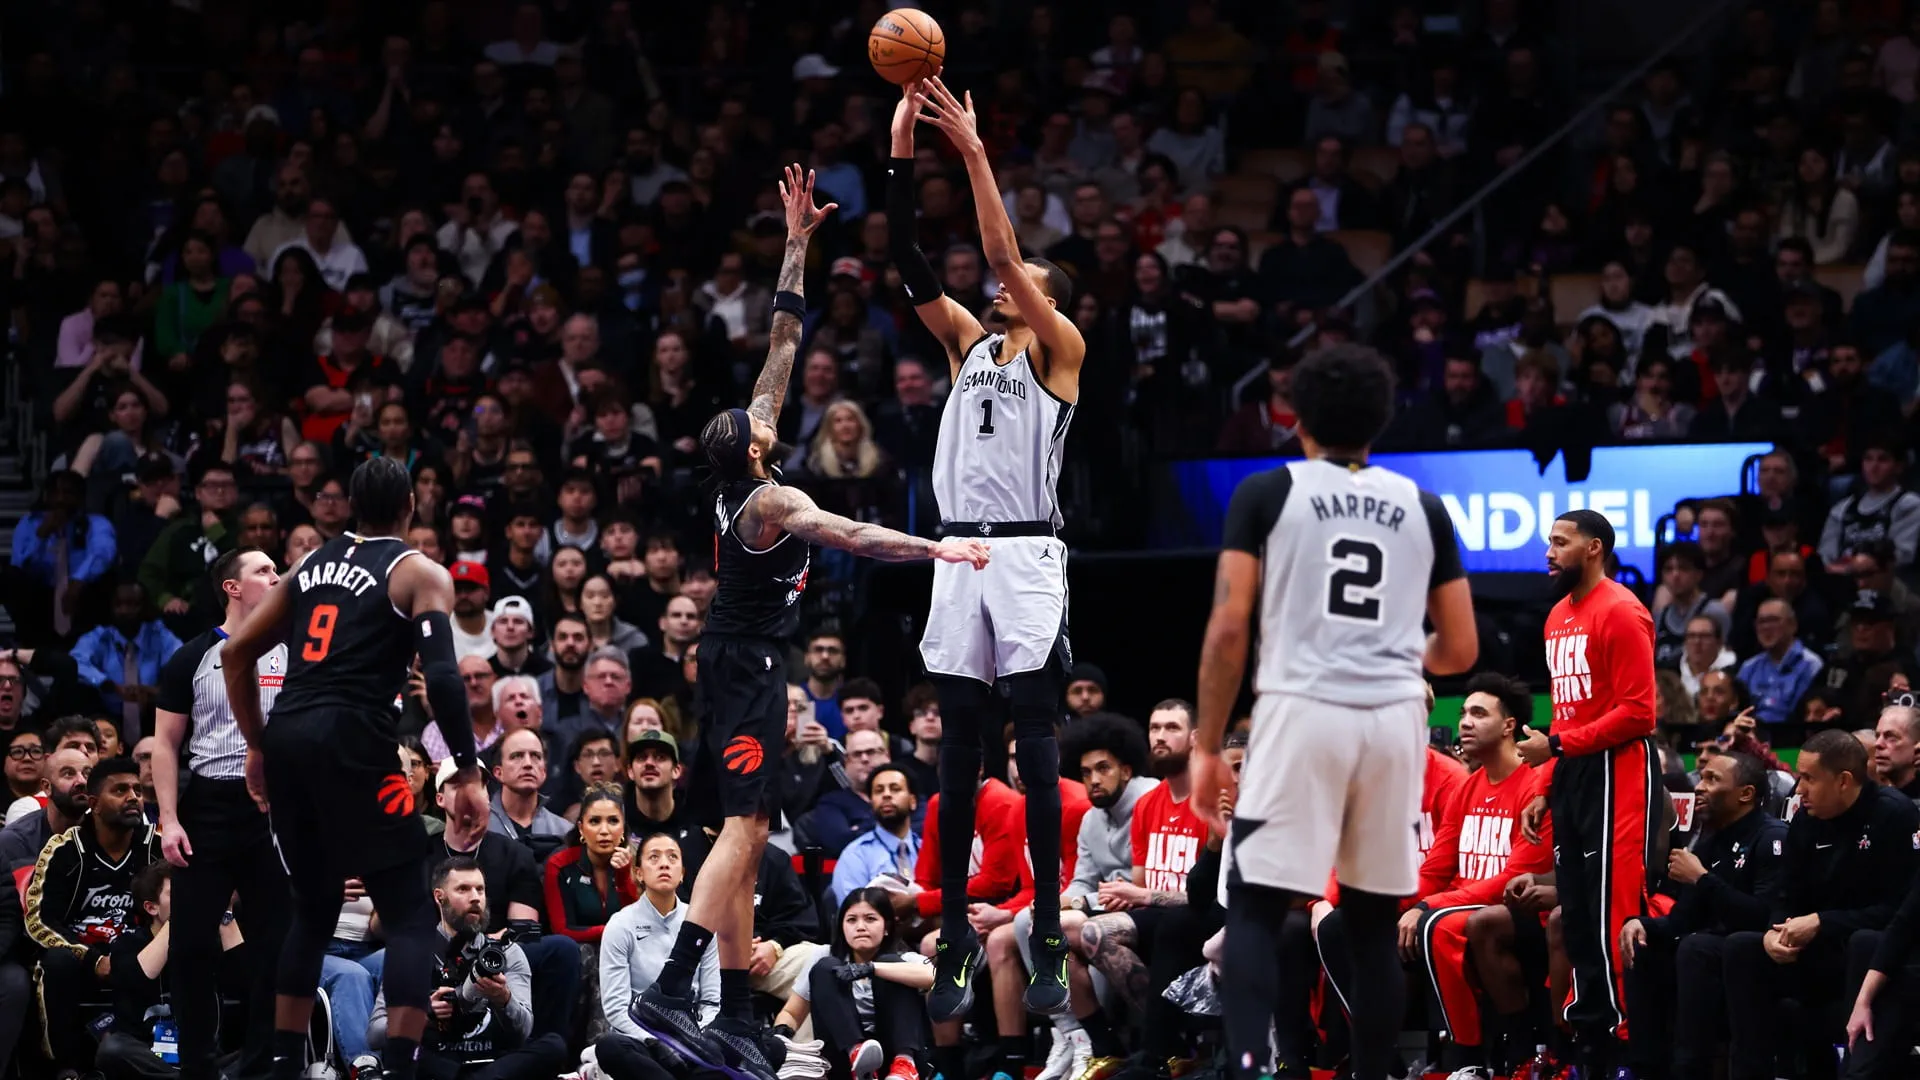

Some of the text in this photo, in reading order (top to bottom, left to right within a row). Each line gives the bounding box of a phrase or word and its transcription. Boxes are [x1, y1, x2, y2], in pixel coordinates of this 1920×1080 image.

[979, 399, 995, 434] 1
[1310, 493, 1406, 532] HARPER
[298, 561, 378, 597] BARRETT
[1328, 538, 1384, 621] 2
[302, 603, 340, 662] 9
[1459, 815, 1513, 856] BLACK
